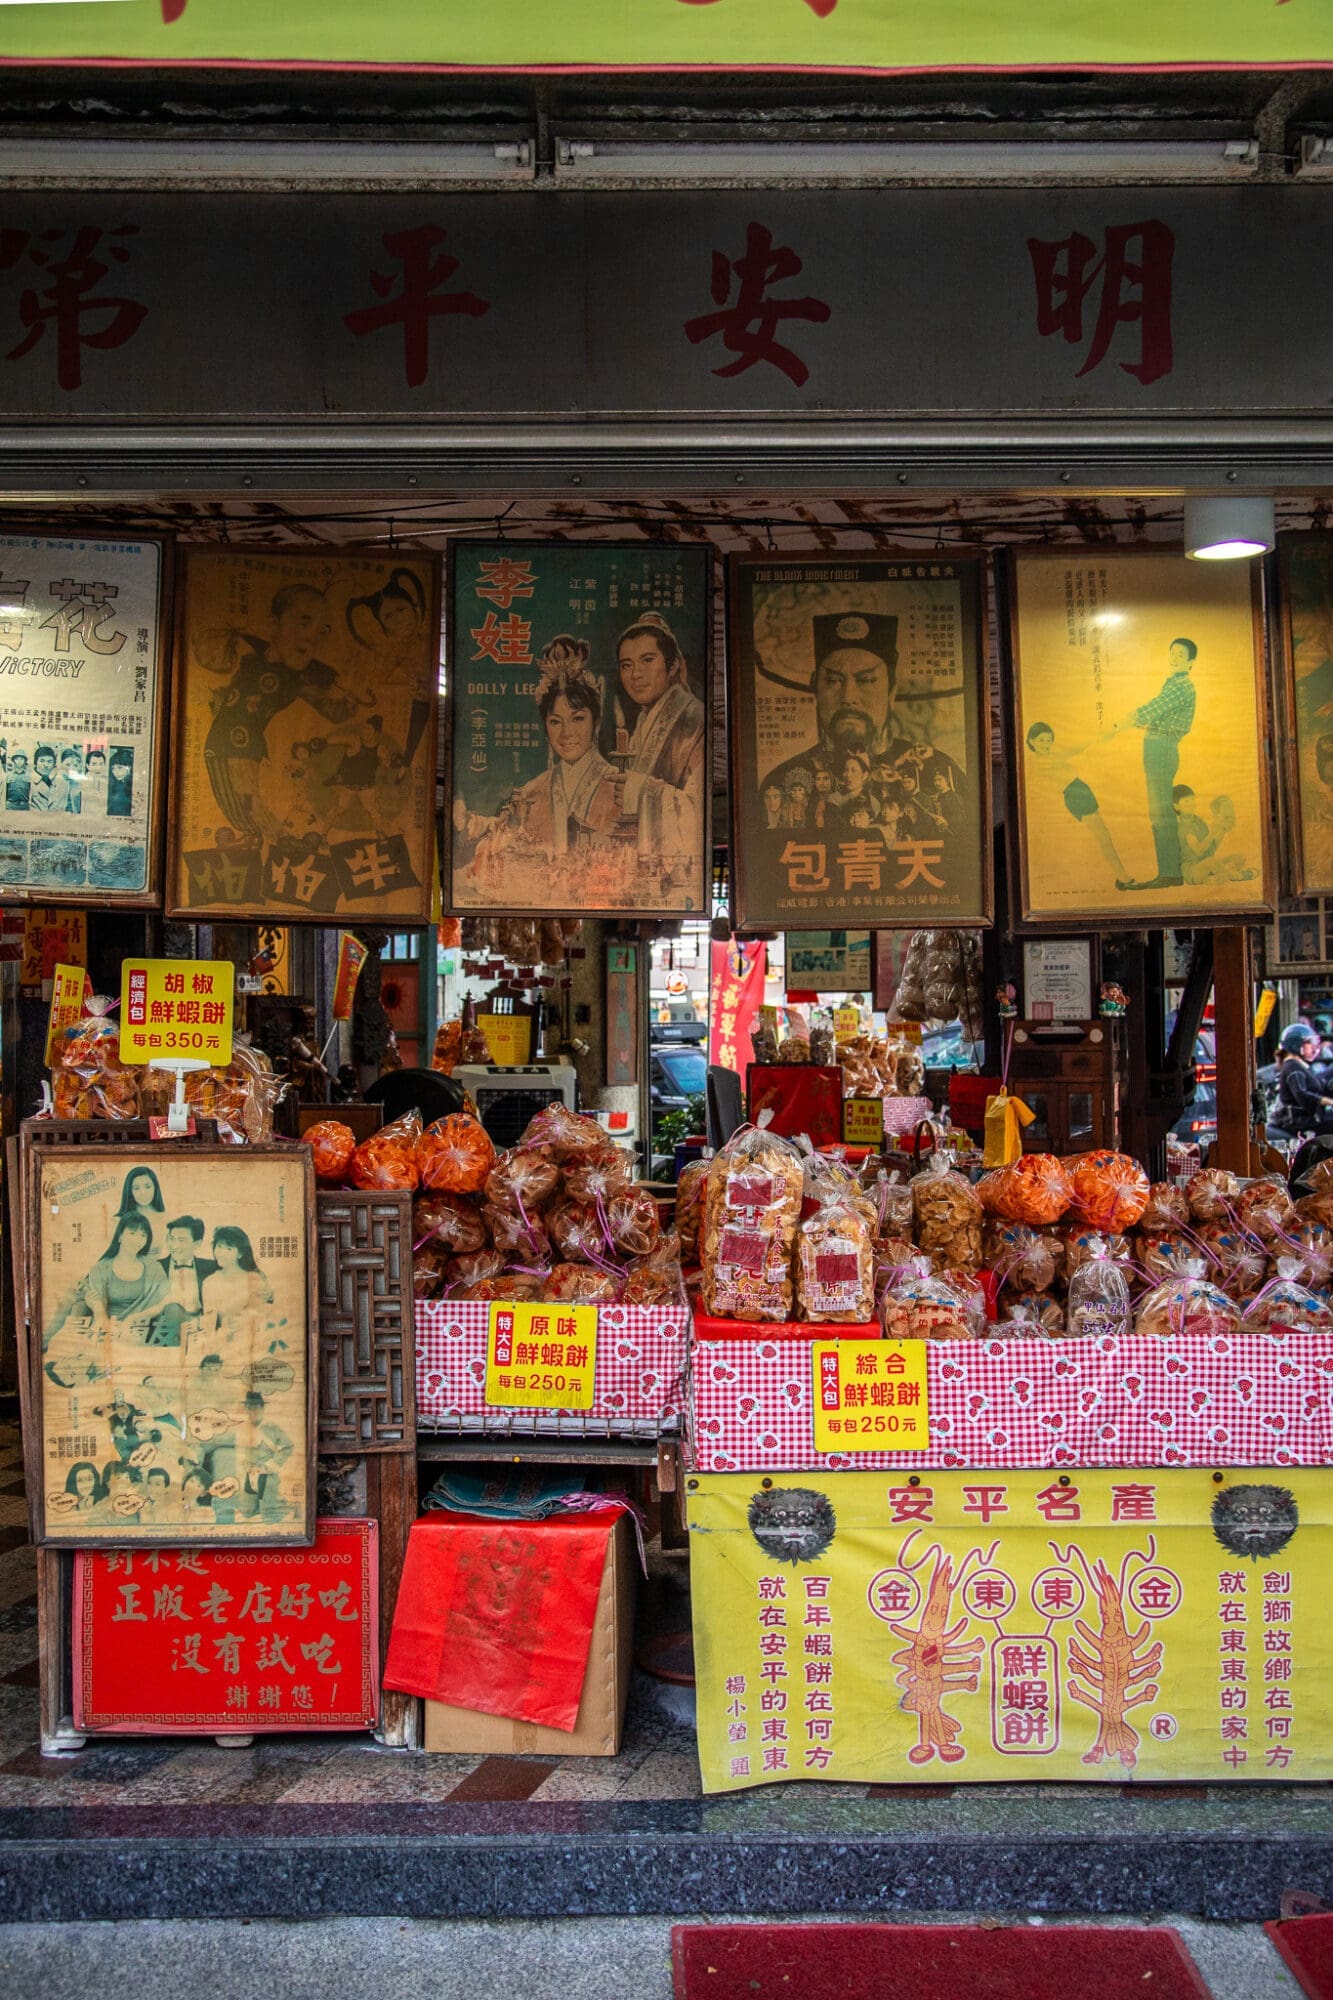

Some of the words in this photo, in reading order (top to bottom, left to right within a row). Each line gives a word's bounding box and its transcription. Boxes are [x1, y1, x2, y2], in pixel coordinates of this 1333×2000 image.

[470, 558, 538, 664] 李娃
[467, 683, 507, 695] DOLLY
[515, 683, 536, 695] LEE
[779, 839, 947, 891] 包青天
[130, 974, 145, 1021] 經濟包
[164, 973, 214, 994] 胡椒
[150, 1001, 226, 1025] 鮮蝦餅
[133, 1032, 220, 1049] 每包350元
[497, 1314, 512, 1363] 特大包
[529, 1315, 578, 1337] 原味
[515, 1341, 589, 1368] 鮮蝦餅
[855, 1353, 906, 1375] 綜合
[498, 1374, 583, 1392] 每包250元
[822, 1354, 838, 1406] 特大包
[844, 1381, 920, 1408] 鮮蝦餅
[827, 1415, 916, 1434] 每包250元
[888, 1483, 1157, 1524] 安平名產
[111, 1581, 359, 1624] 正版老店好吃
[877, 1579, 912, 1612] 金
[973, 1579, 1006, 1611] 東
[1041, 1577, 1076, 1610] 東
[1138, 1576, 1172, 1609] 金
[171, 1634, 343, 1675] 沒有試吃
[1218, 1571, 1248, 1768] 就在東東的家中
[1262, 1571, 1294, 1769] 劍獅故鄉在何方
[758, 1576, 789, 1771] 就在安平的東東
[803, 1576, 833, 1769] 百年蝦餅在何方
[1001, 1644, 1050, 1746] 鮮蝦餅
